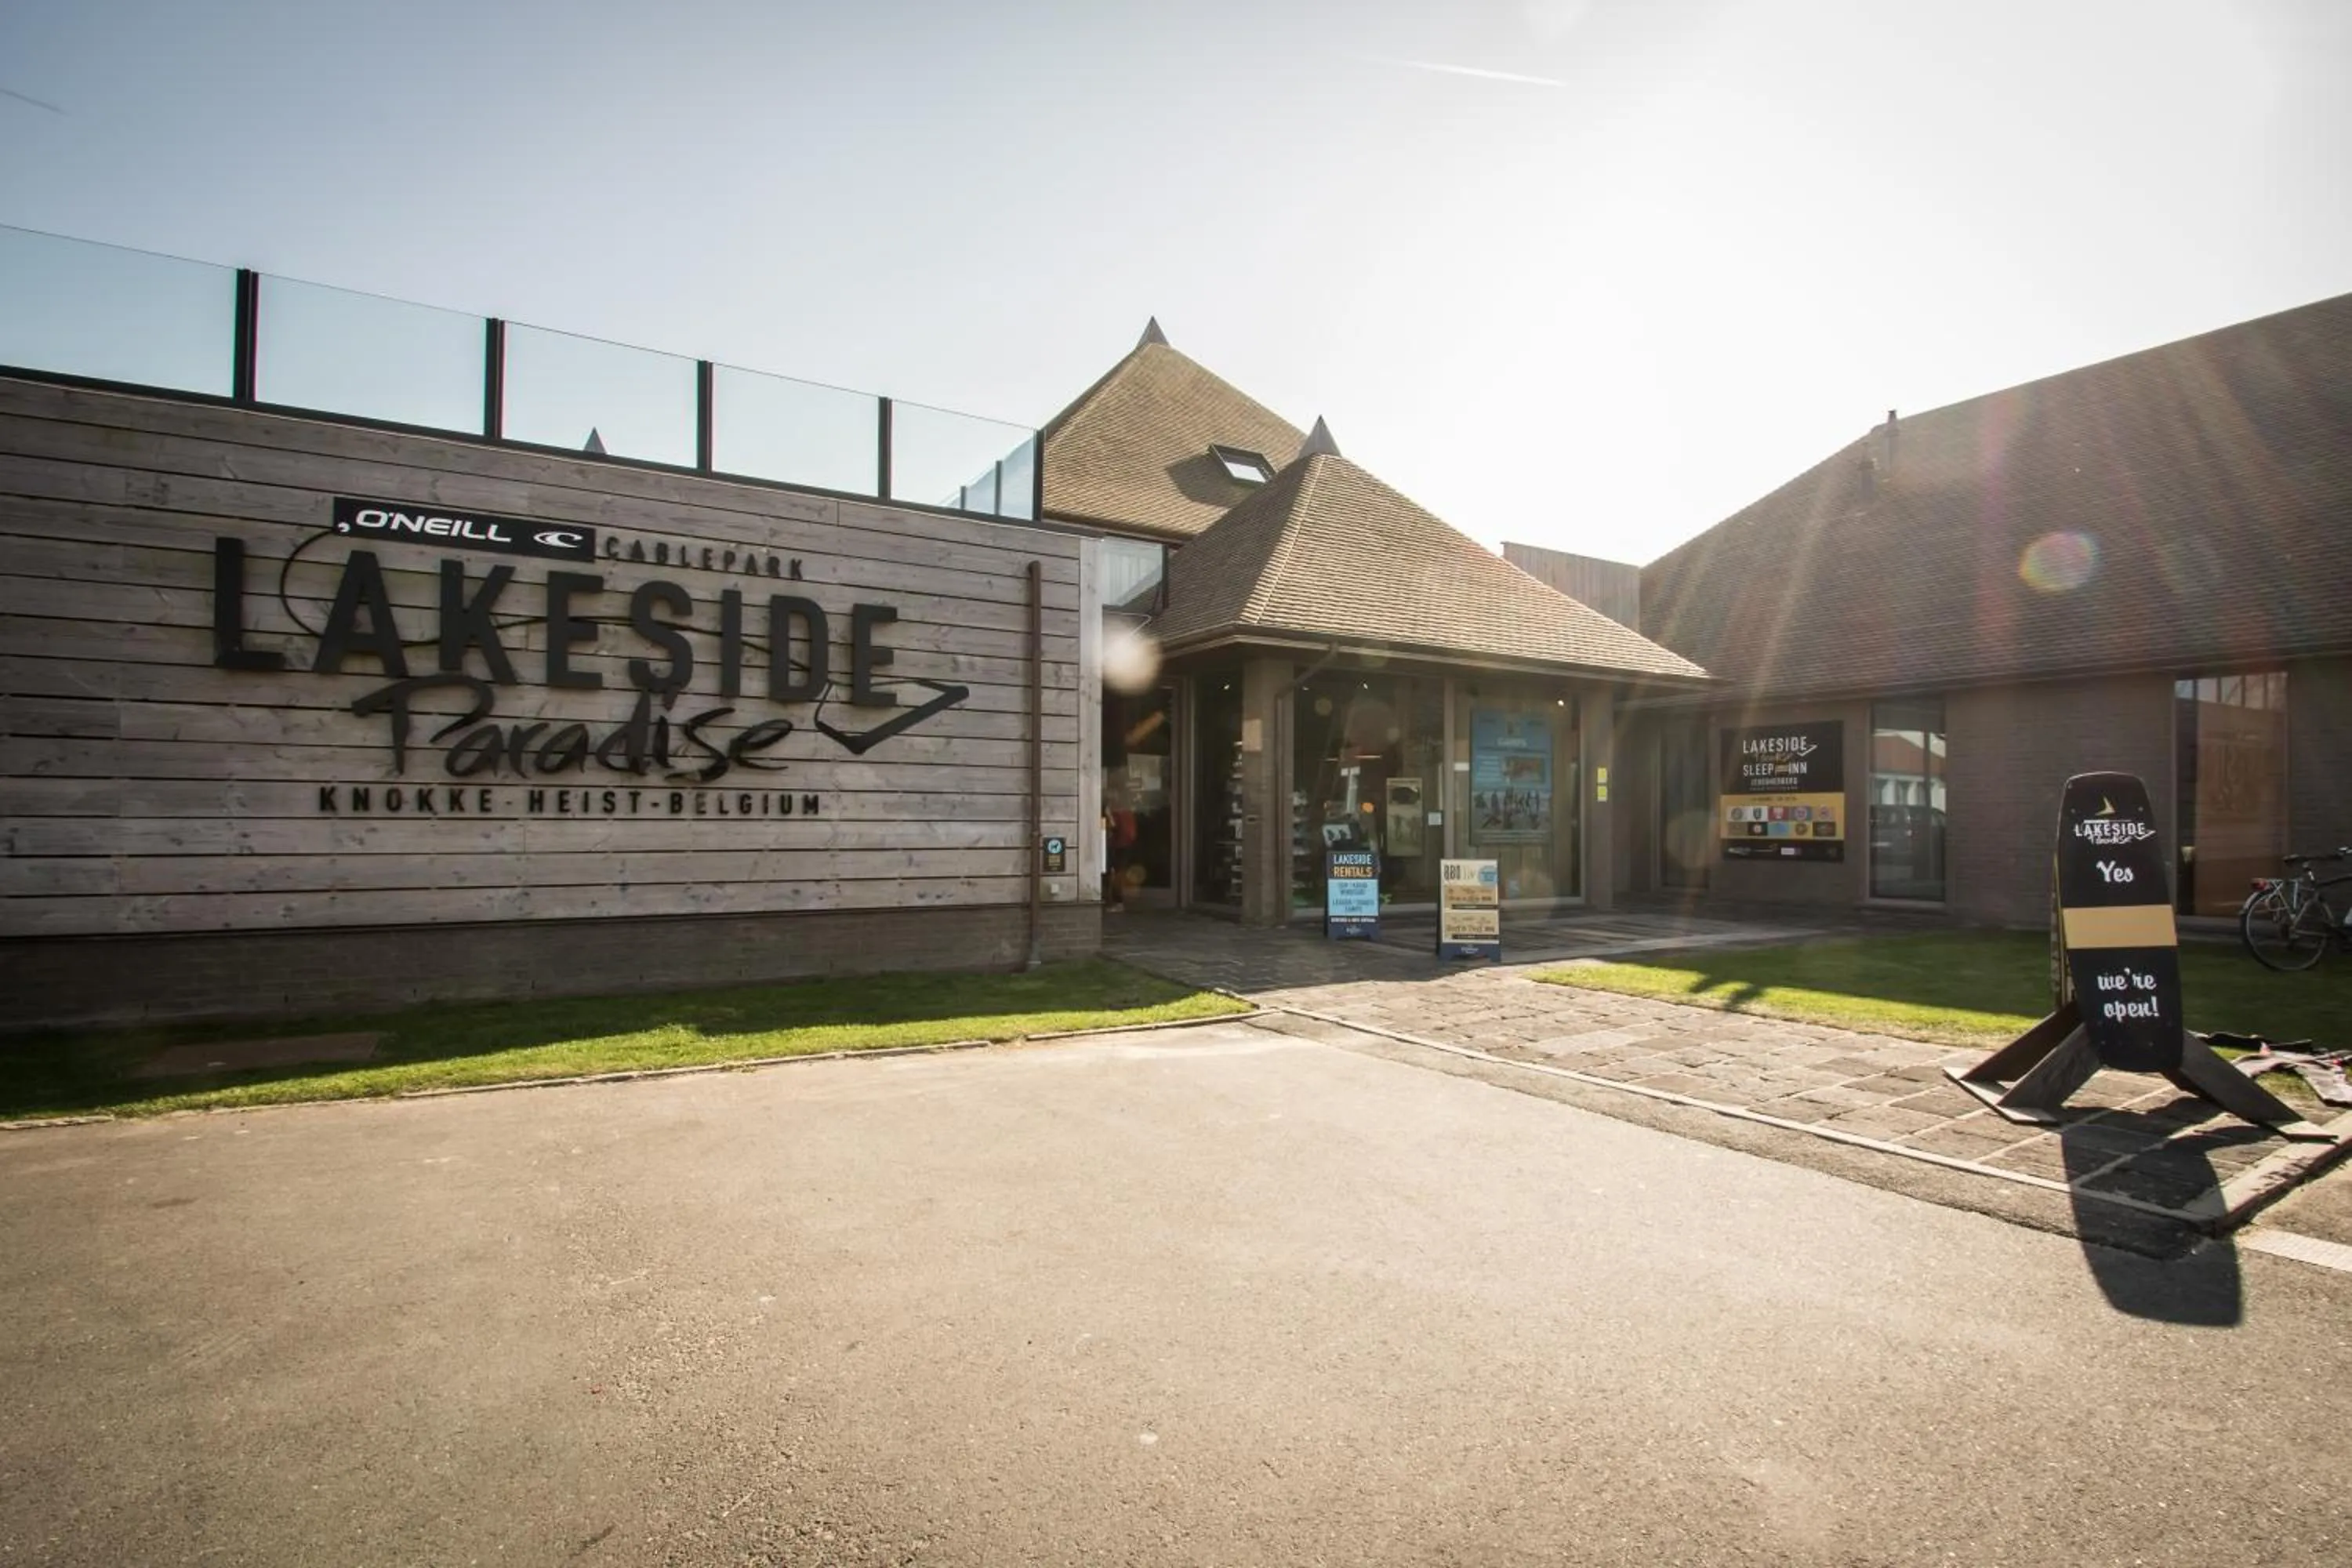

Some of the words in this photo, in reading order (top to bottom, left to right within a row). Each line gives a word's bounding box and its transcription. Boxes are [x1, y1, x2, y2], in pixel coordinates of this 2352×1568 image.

[604, 535, 804, 581] CABLEPARK
[212, 536, 898, 708] LAKESIDE
[350, 672, 793, 783] Paradise
[1743, 736, 1807, 753] LAKESIDE
[1743, 763, 1774, 776] SLEEP
[1789, 761, 1807, 775] INN
[2074, 822, 2146, 837] LAKESIDE
[1334, 854, 1372, 865] LAKESIDE
[1334, 866, 1372, 878] RENTALS
[2096, 860, 2134, 883] Yes
[2096, 967, 2158, 990] we're
[2103, 996, 2160, 1022] open!
